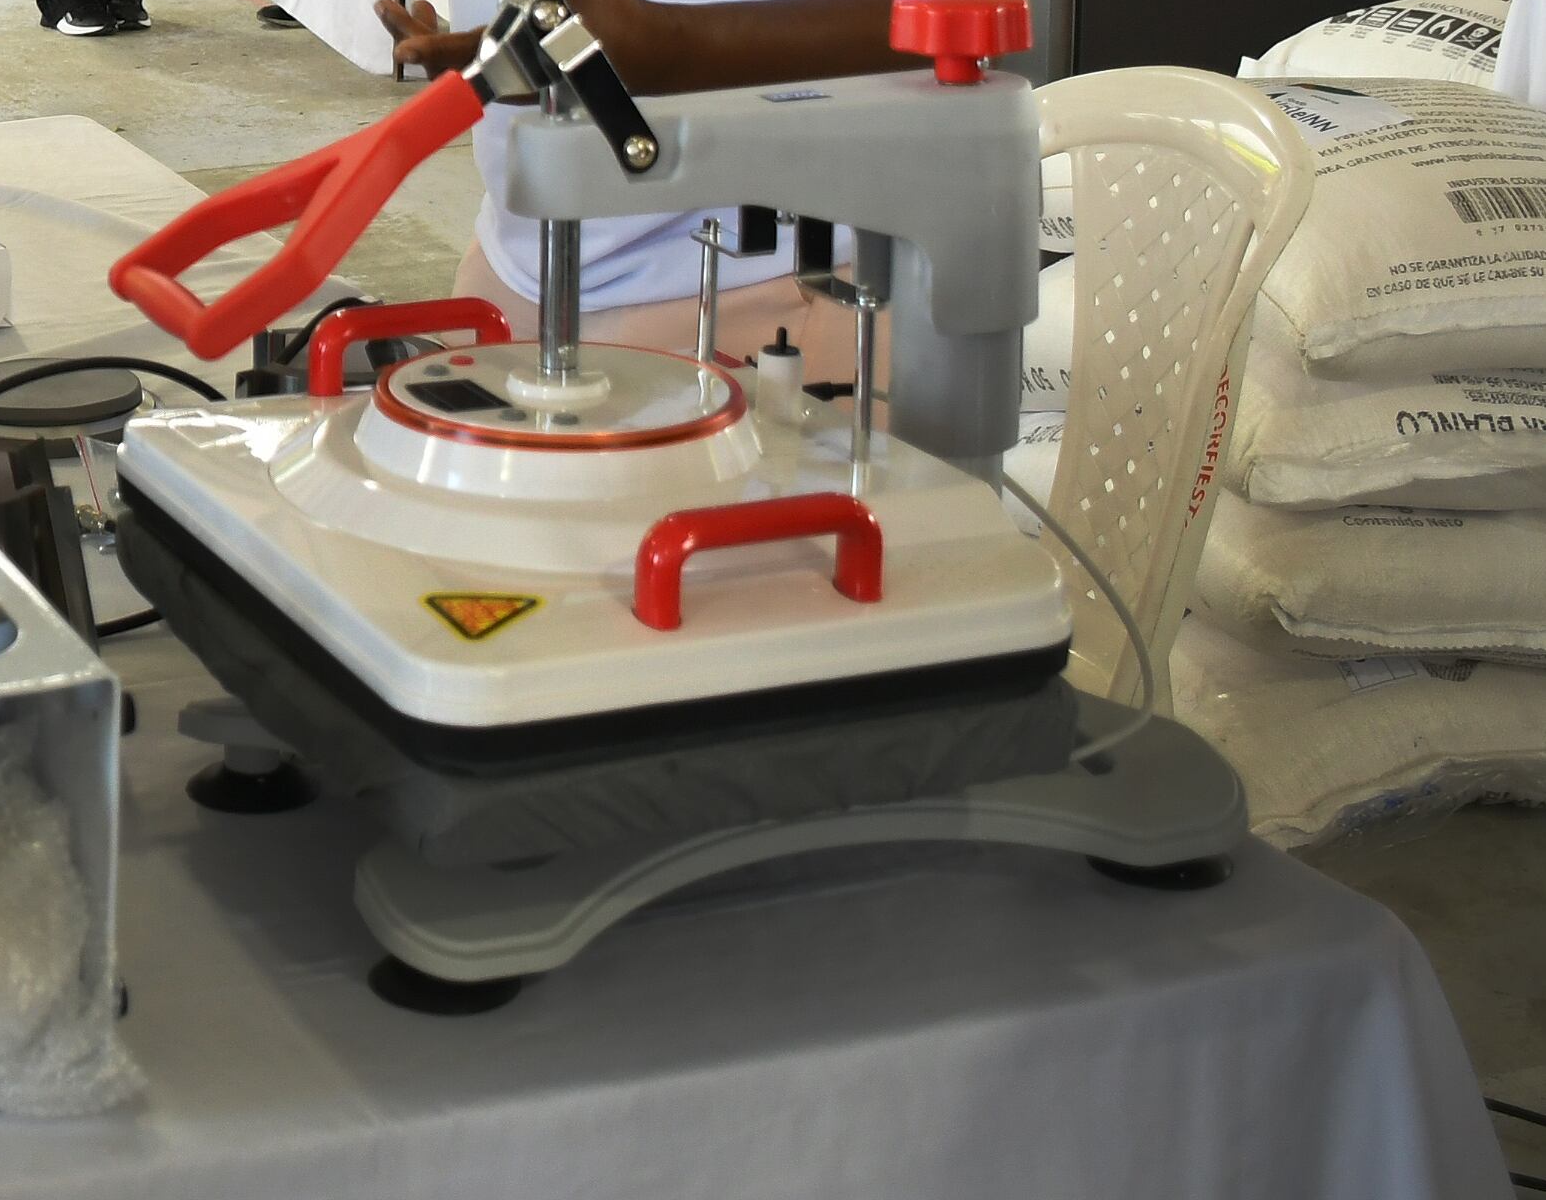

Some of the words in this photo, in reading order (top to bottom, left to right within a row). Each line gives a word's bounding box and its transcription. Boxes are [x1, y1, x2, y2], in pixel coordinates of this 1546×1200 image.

[1377, 128, 1428, 142] PUERTO
[1347, 148, 1407, 167] GRATUITA
[1407, 144, 1427, 155] DE
[1447, 177, 1509, 189] INDUSTRIA
[1389, 263, 1407, 275] NO
[1409, 261, 1424, 273] SE
[1426, 255, 1487, 272] GARANTIZA
[1487, 253, 1503, 265] LA
[1384, 279, 1412, 295] CASO
[1415, 278, 1431, 290] DE
[1432, 275, 1455, 289] QUE
[1530, 265, 1545, 278] SU
[1343, 515, 1424, 527] Contenido
[1426, 516, 1464, 528] Neto
